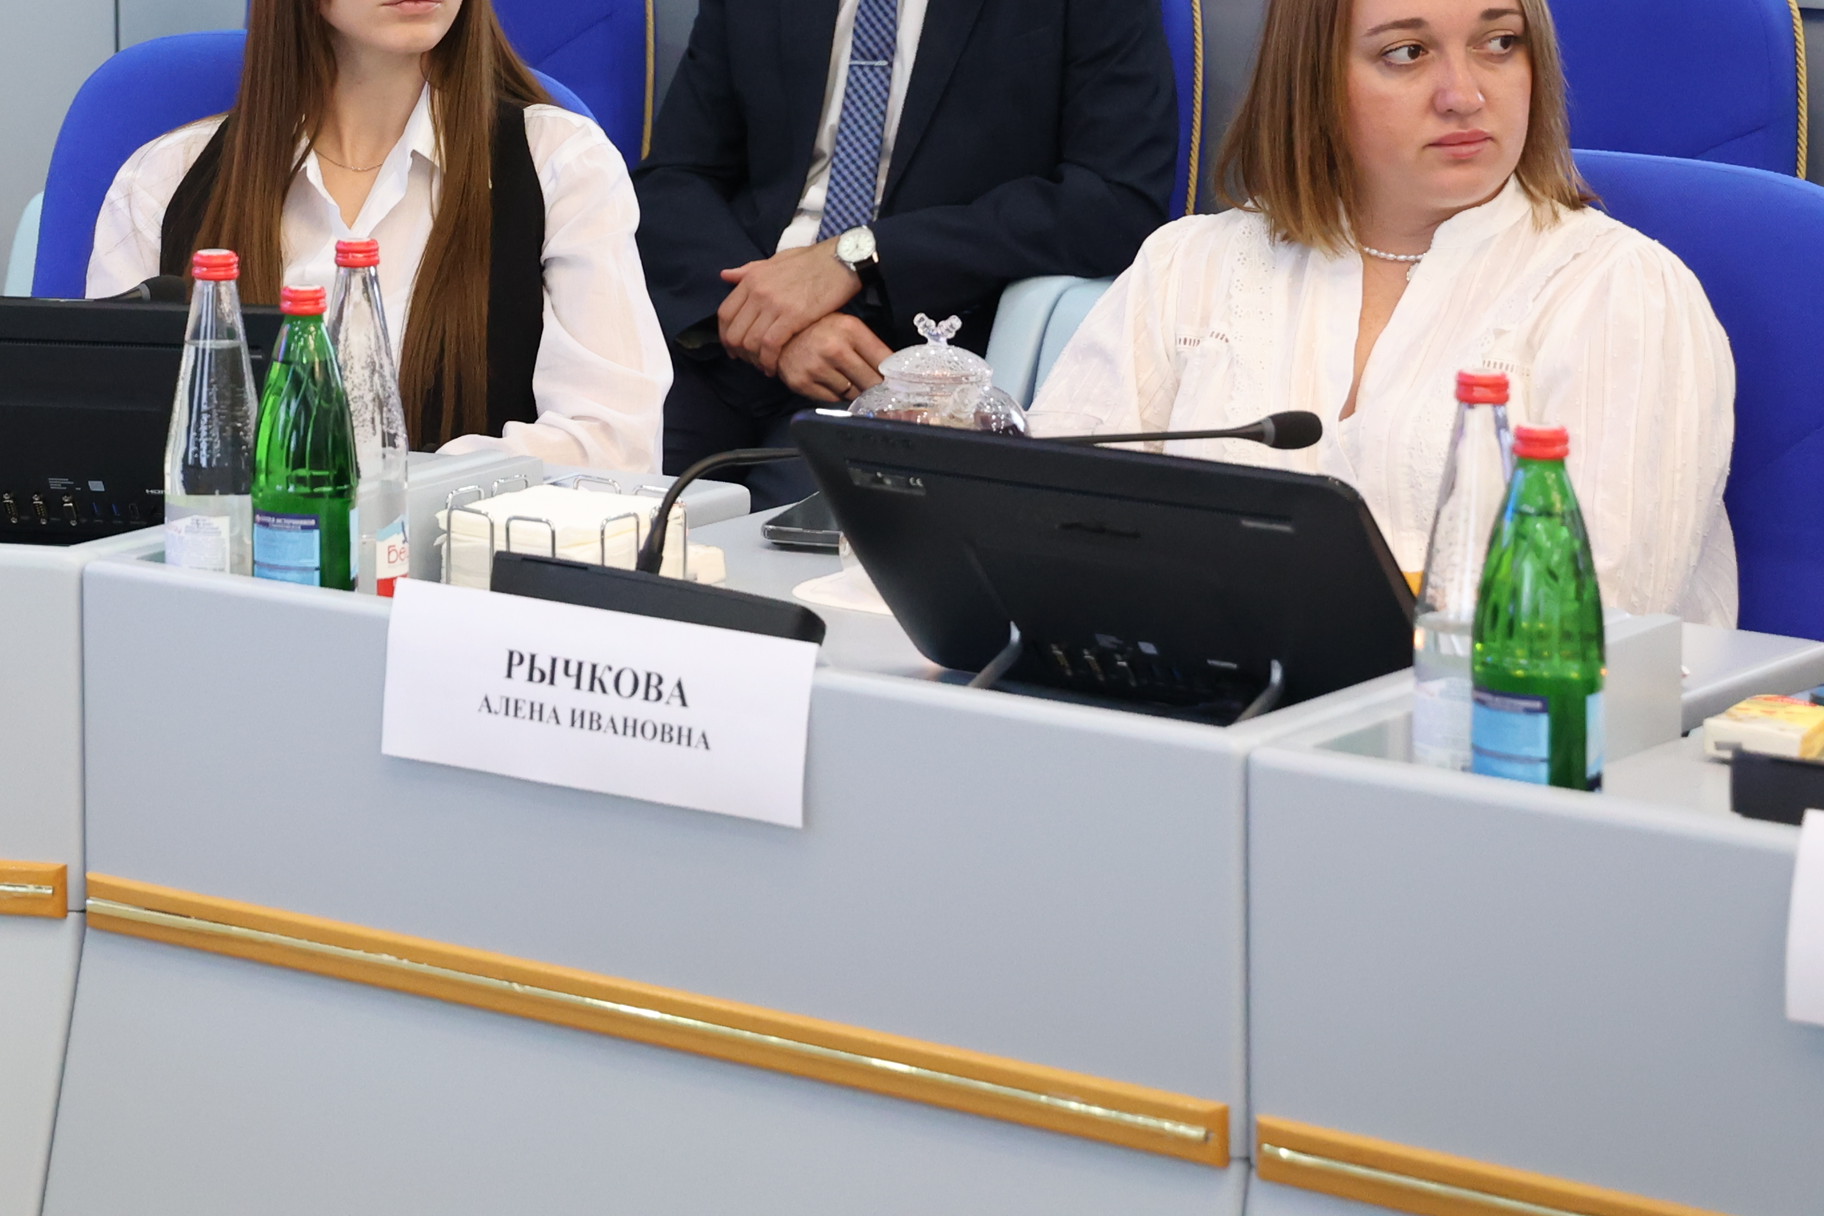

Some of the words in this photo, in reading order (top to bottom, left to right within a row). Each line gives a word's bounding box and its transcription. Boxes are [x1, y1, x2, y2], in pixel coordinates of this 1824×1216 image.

[504, 649, 690, 708] РЫЧКОВА
[477, 693, 561, 726] АЛЕНА
[569, 708, 712, 751] ИВАНОВНА
